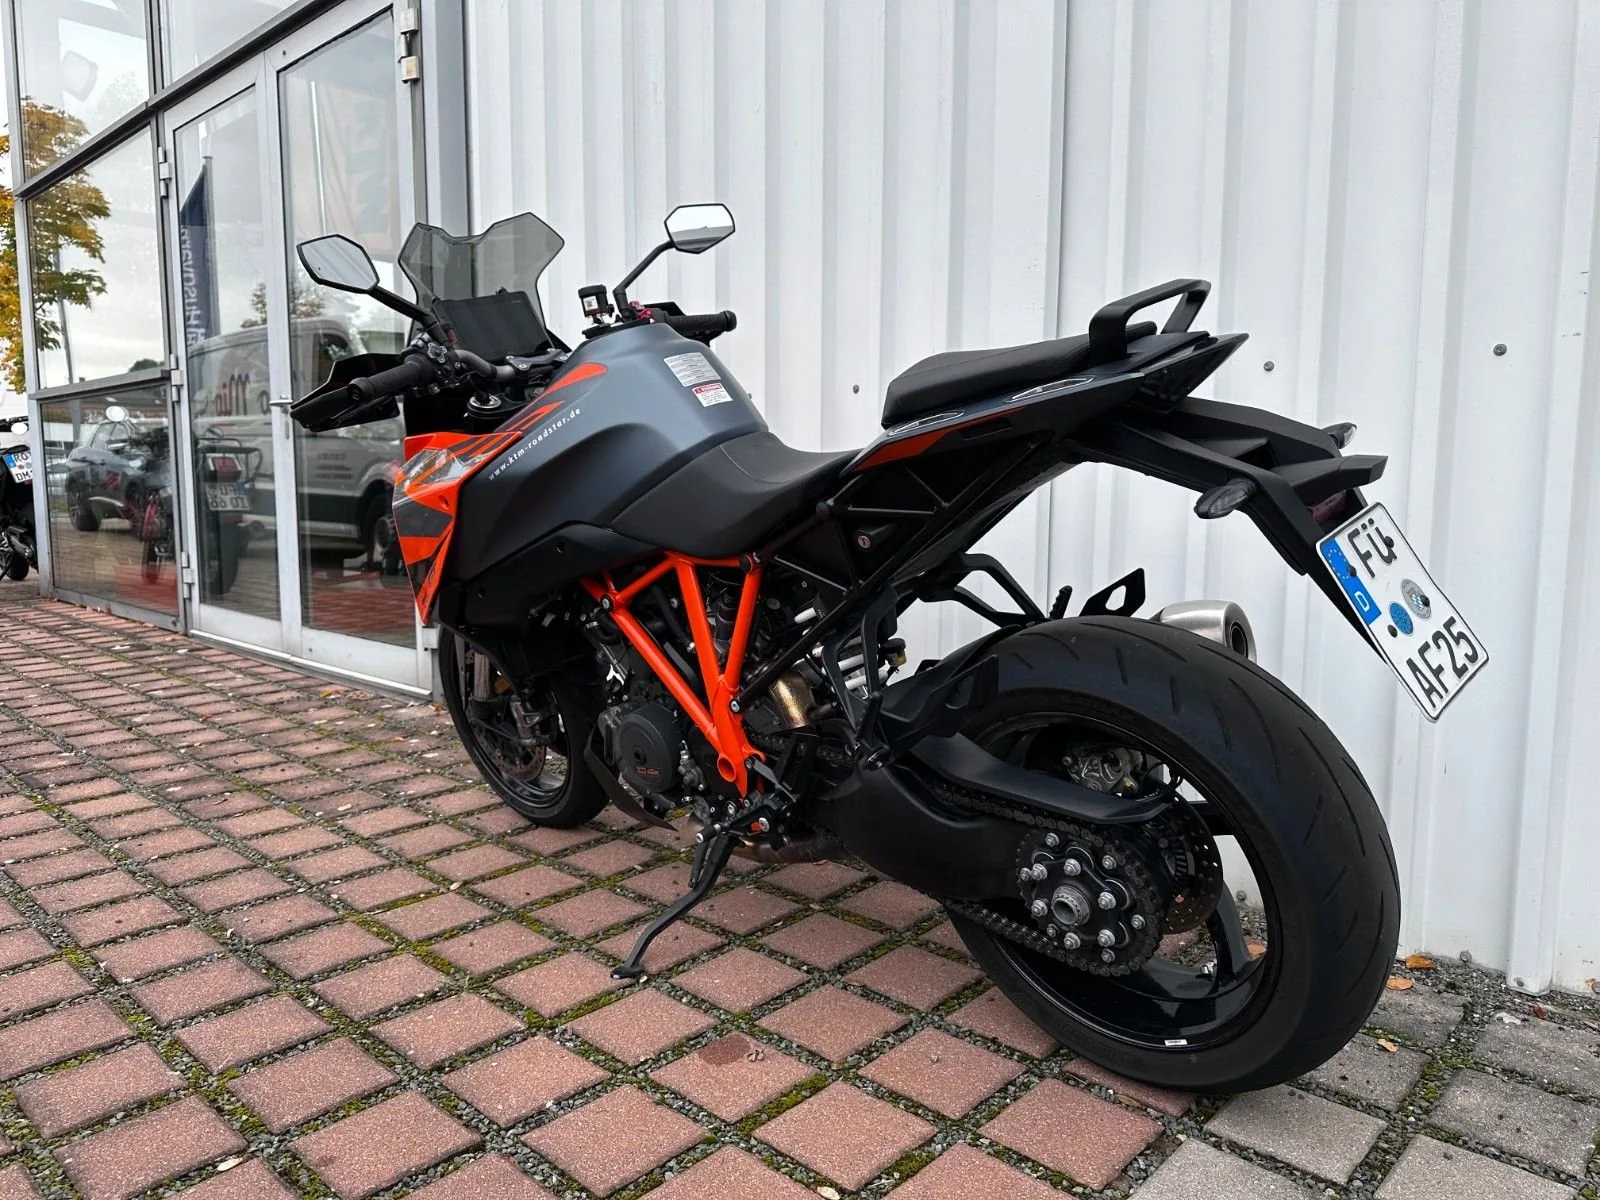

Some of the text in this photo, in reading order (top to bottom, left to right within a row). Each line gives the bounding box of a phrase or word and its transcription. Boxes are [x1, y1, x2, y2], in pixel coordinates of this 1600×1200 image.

[489, 408, 581, 481] www.ktm-roadstar.de
[1346, 517, 1397, 579] FÜ
[1354, 590, 1371, 613] D
